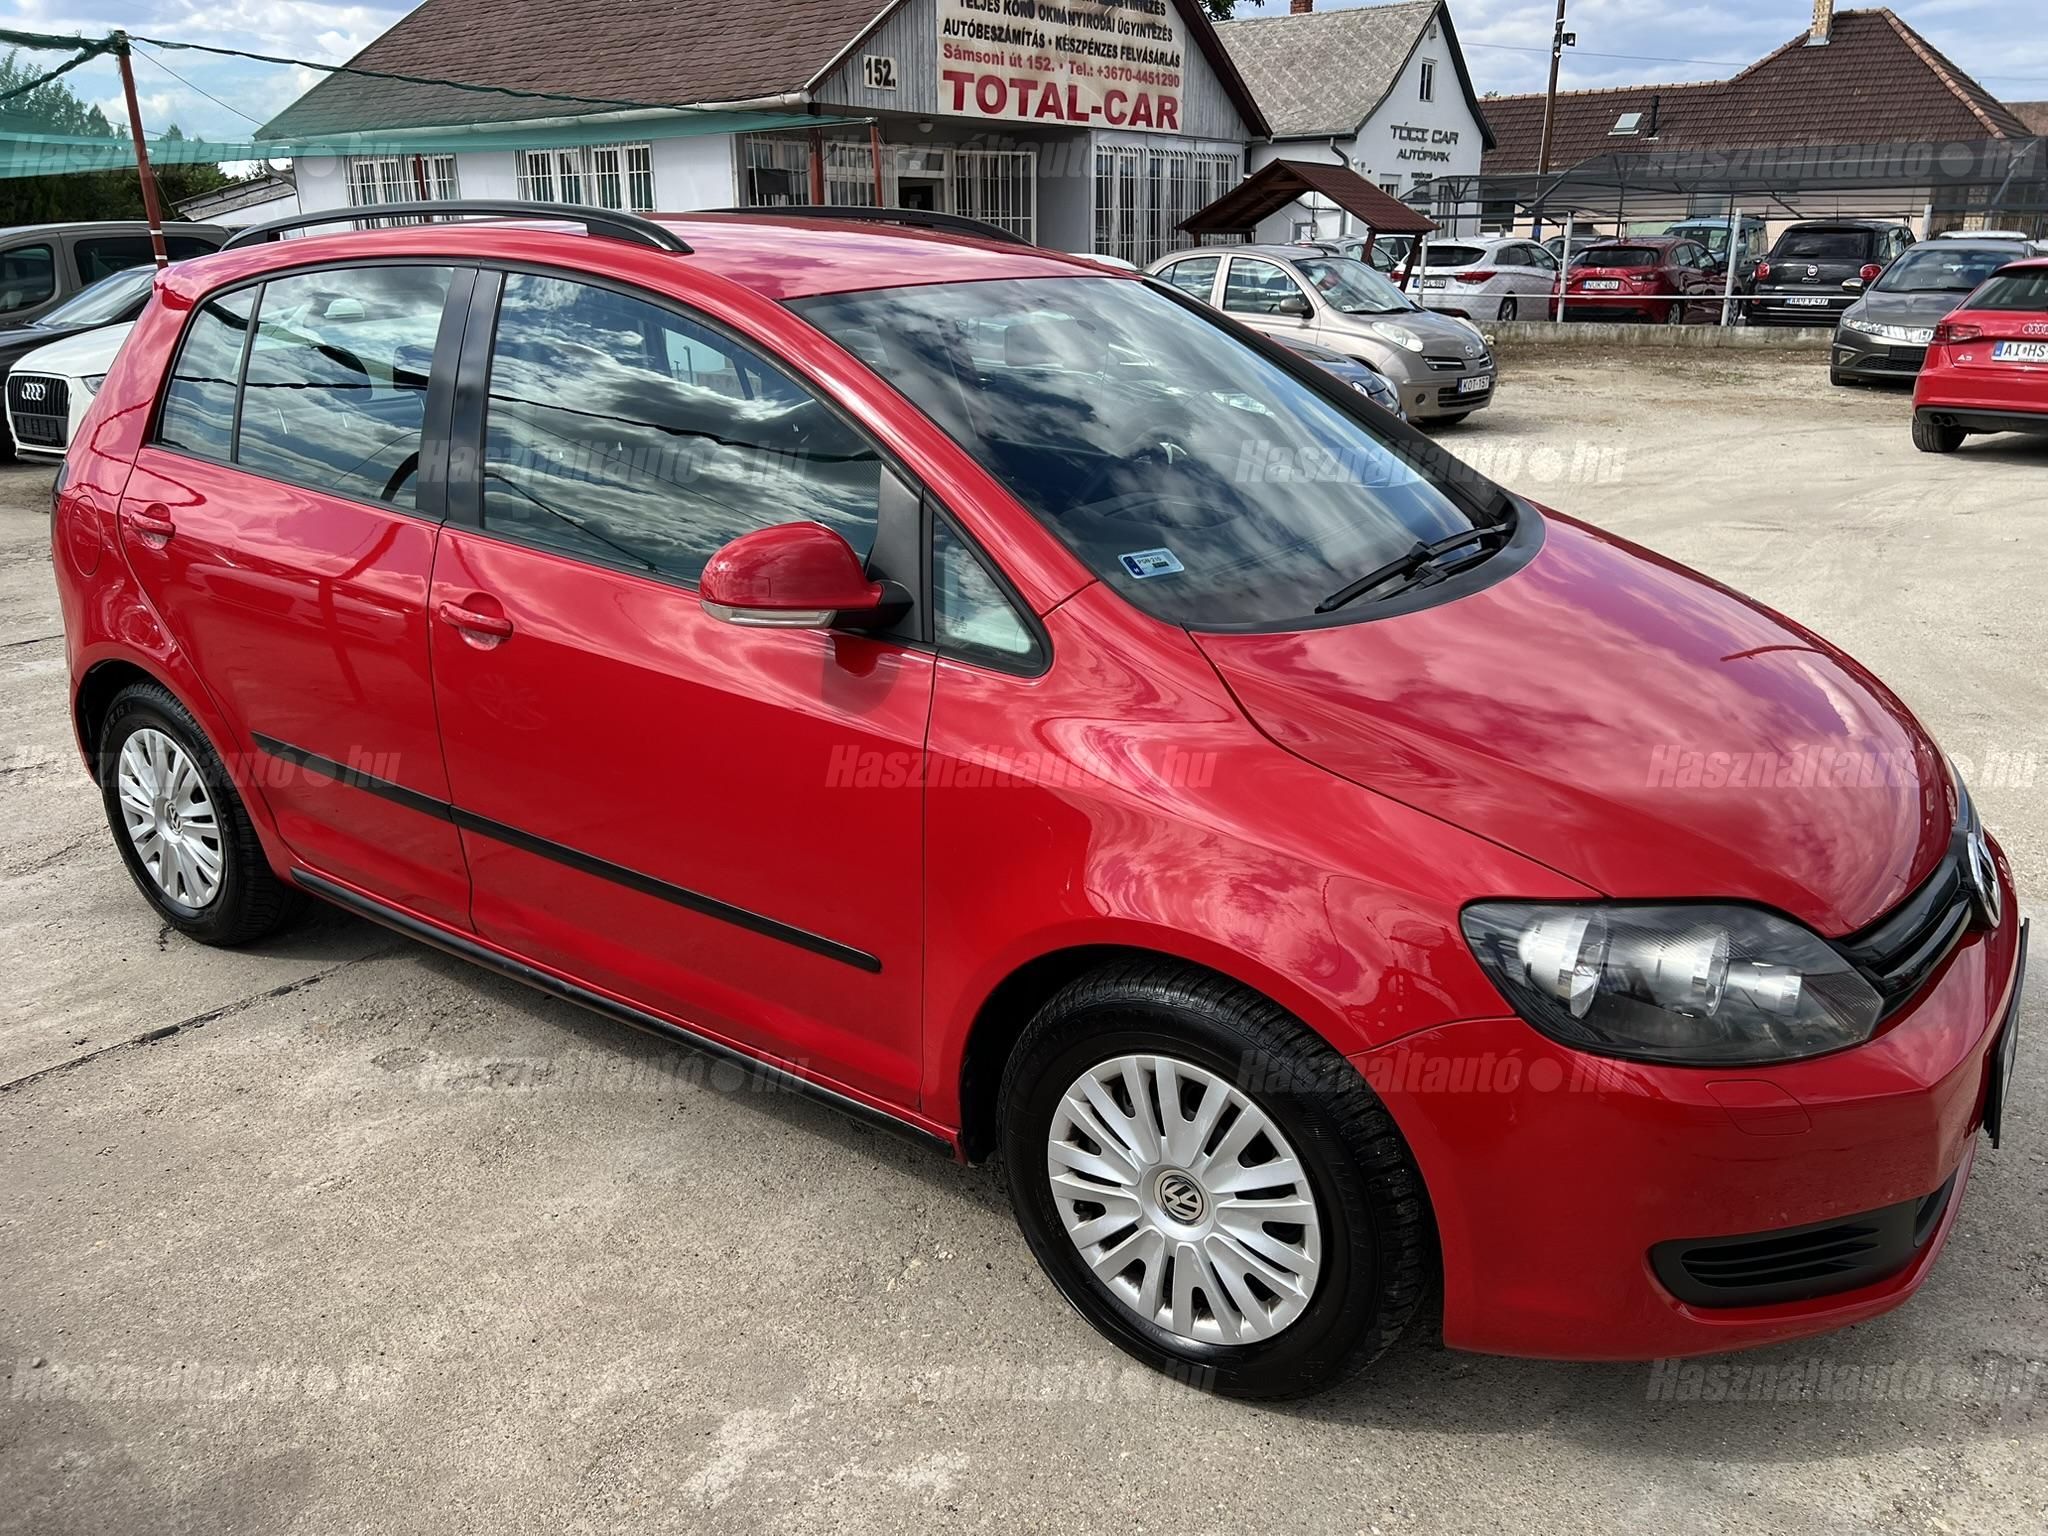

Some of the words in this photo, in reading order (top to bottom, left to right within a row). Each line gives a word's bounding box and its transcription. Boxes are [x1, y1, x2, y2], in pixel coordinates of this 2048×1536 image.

[1038, 4, 1115, 33] OKMÁNYIRODAI
[1117, 17, 1173, 42] ÜGYINTÉZÉS
[943, 18, 1045, 49] AUTÓBESZÁMÍTÁS
[1055, 34, 1118, 59] KÉSZPÉNZES
[1120, 46, 1180, 68] FELVÁSÁRLÁS
[865, 56, 896, 87] 152.
[943, 43, 1004, 66] Sámsoni
[1009, 53, 1023, 68] út
[1026, 55, 1055, 72] 152.
[1069, 60, 1093, 77] Tel.:
[1097, 65, 1180, 88] +3670-4451290
[942, 69, 1179, 131] TOTAL-CAR
[1396, 146, 1450, 162] AUTÓPARK
[1431, 129, 1459, 145] CAR
